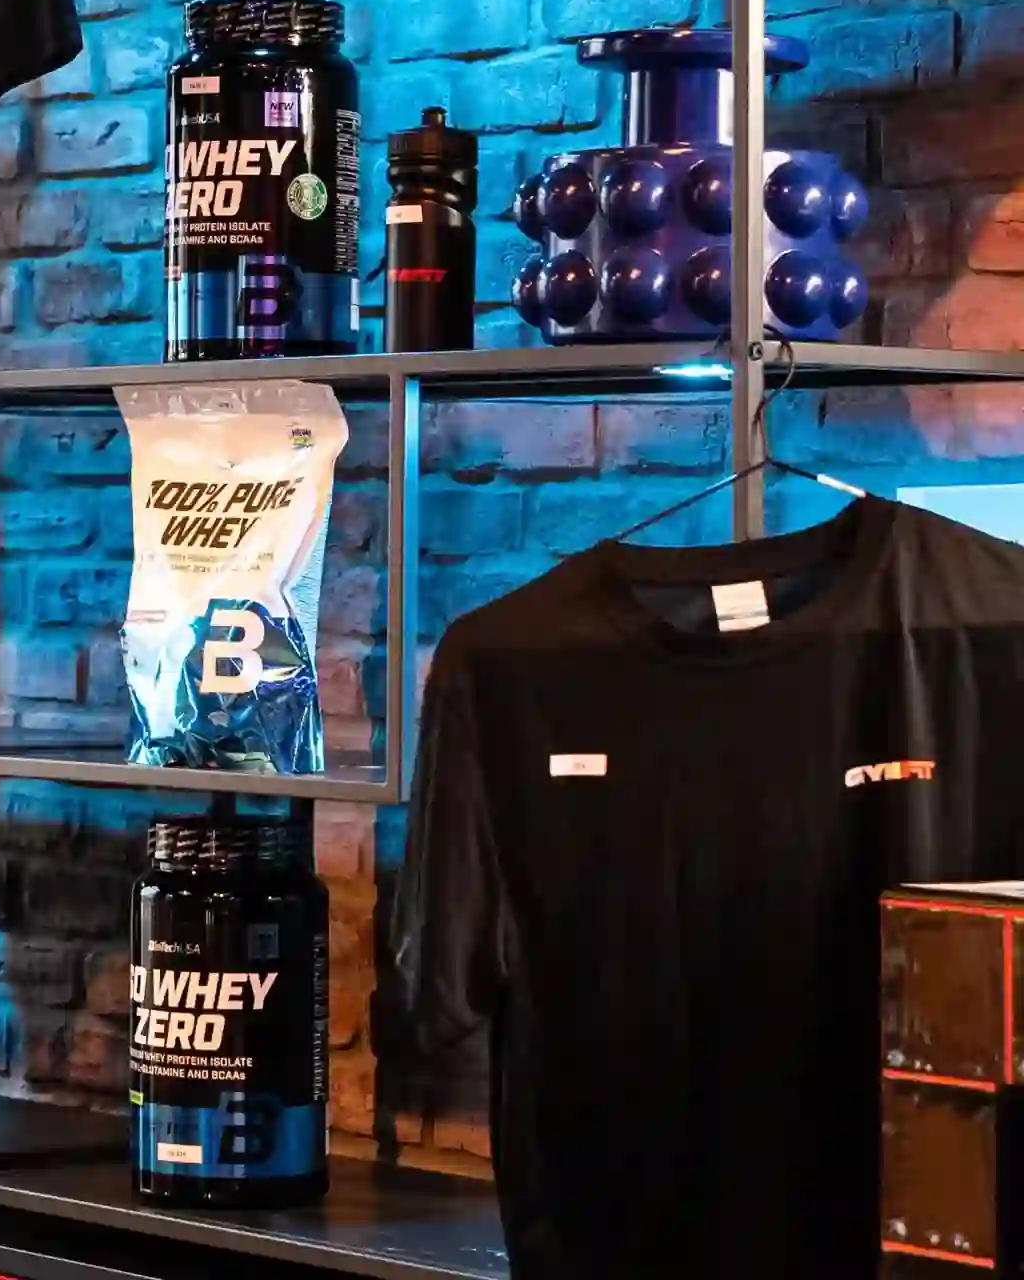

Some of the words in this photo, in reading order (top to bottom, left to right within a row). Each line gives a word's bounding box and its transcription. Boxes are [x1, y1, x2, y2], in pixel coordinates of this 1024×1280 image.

[178, 139, 297, 178] WHEY
[190, 222, 227, 232] PROTEIN
[229, 221, 272, 232] ISOLATE
[207, 234, 228, 245] AND
[230, 234, 264, 245] BCAAs
[145, 479, 228, 513] 100%
[223, 476, 305, 513] PURE
[161, 515, 258, 549] WHEY
[199, 608, 265, 694] B
[153, 968, 278, 1010] WHEY
[134, 1007, 226, 1051] ZERO
[166, 1053, 208, 1067] PROTEIN
[210, 1057, 253, 1068] ISOLATE
[187, 1069, 209, 1080] AND
[211, 1070, 246, 1081] BCAAs
